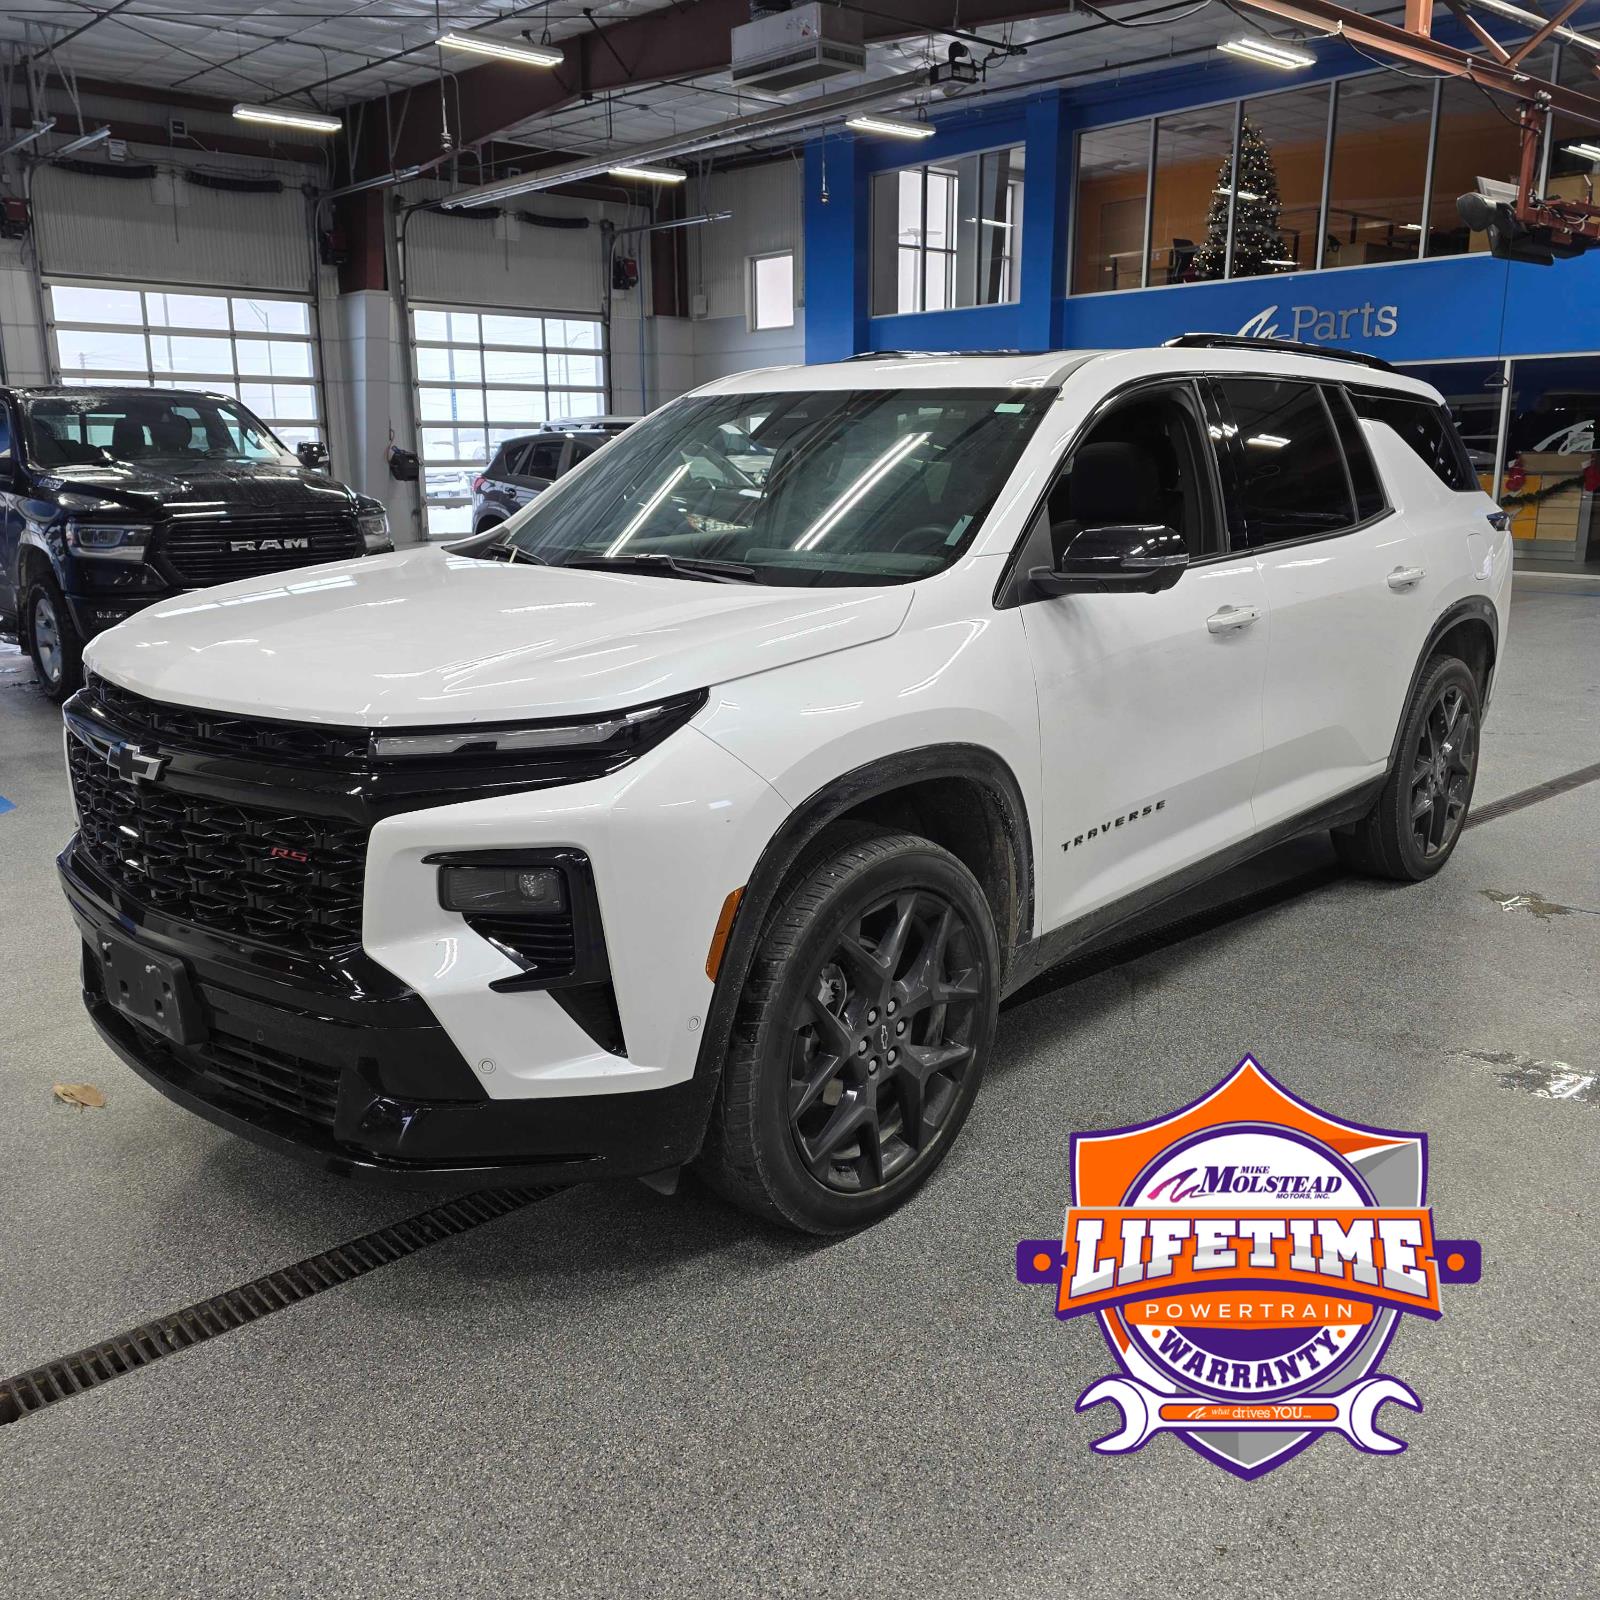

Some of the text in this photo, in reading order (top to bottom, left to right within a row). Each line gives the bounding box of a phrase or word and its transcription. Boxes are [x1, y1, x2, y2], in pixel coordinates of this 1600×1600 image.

[1291, 301, 1399, 341] Parts
[230, 537, 308, 552] RAM
[1061, 800, 1166, 852] TRAVERSE
[271, 847, 308, 862] RS
